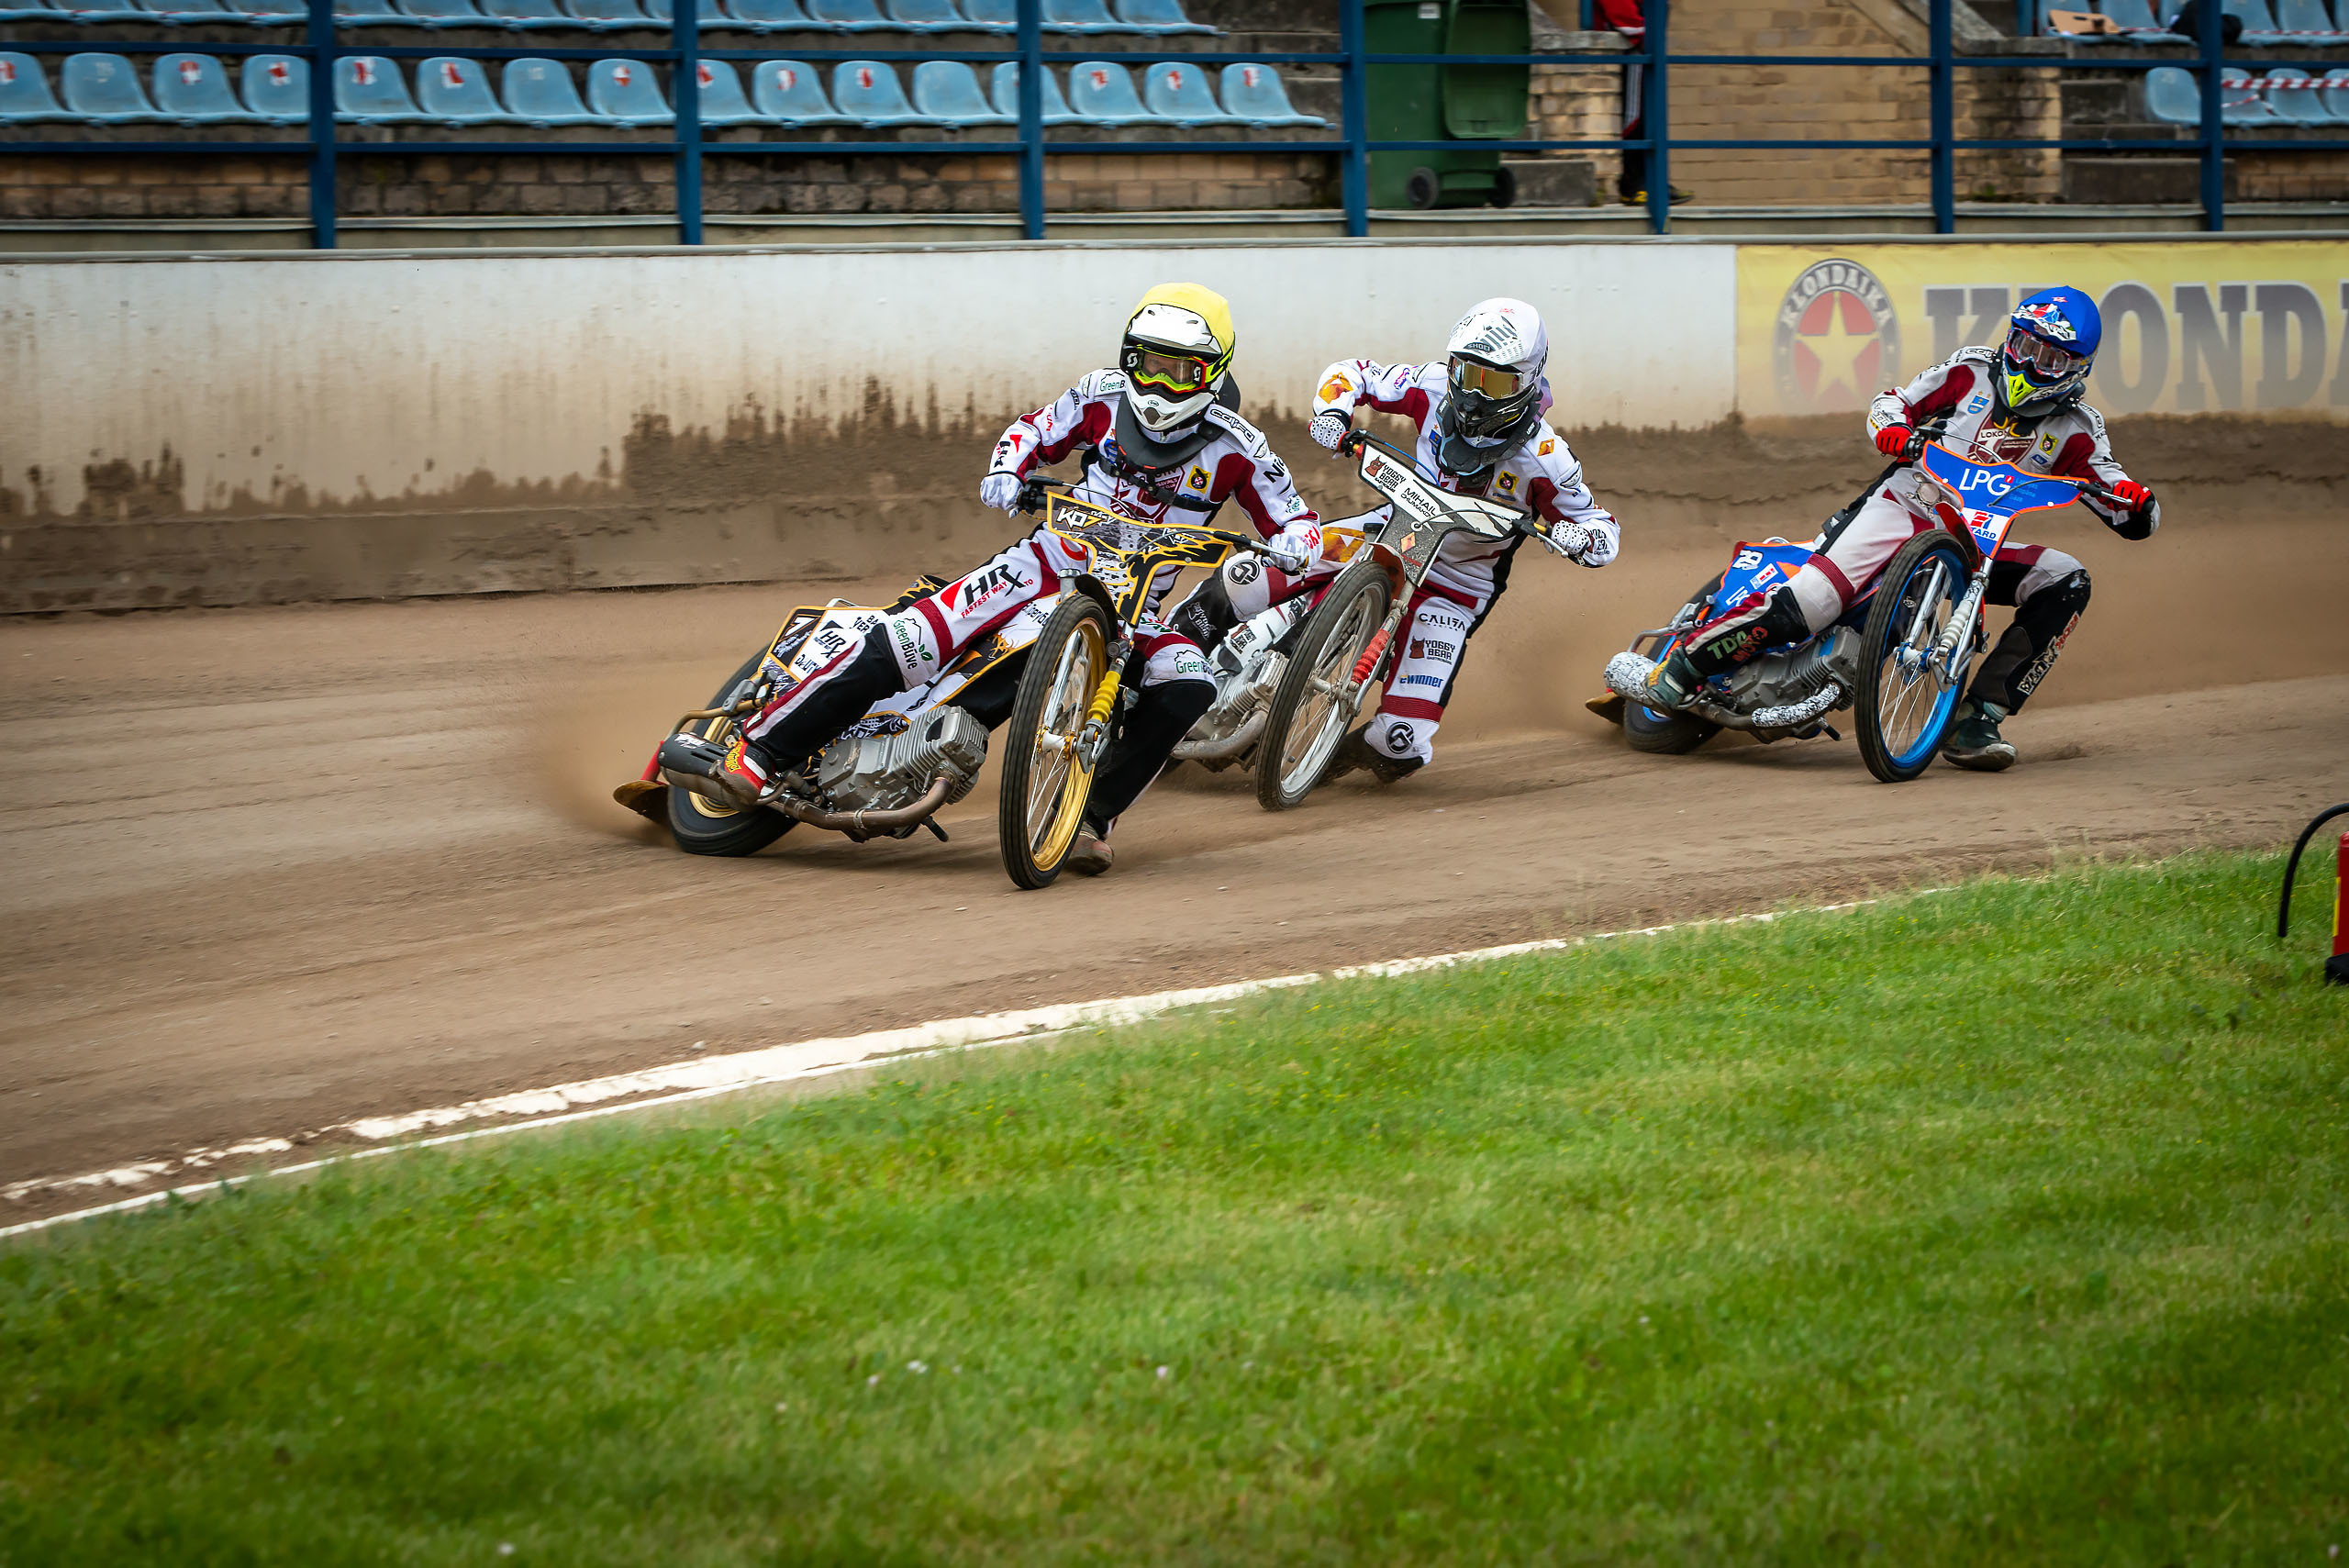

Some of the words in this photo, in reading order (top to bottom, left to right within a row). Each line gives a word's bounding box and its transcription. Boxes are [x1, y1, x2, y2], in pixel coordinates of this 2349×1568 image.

[1779, 264, 1894, 328] KLONDAIKA
[1468, 342, 1491, 353] SHOEI
[1959, 468, 2011, 496] LPG
[1404, 487, 1436, 516] MIHAIL
[961, 592, 992, 619] FASTEST
[991, 581, 1008, 595] WAY
[1023, 578, 1034, 586] TO
[963, 564, 1026, 606] HRX
[893, 619, 918, 670] GreenBūve
[1425, 639, 1456, 652] YOGGY
[1428, 648, 1453, 660] BEAR
[1399, 674, 1443, 688] ewinner
